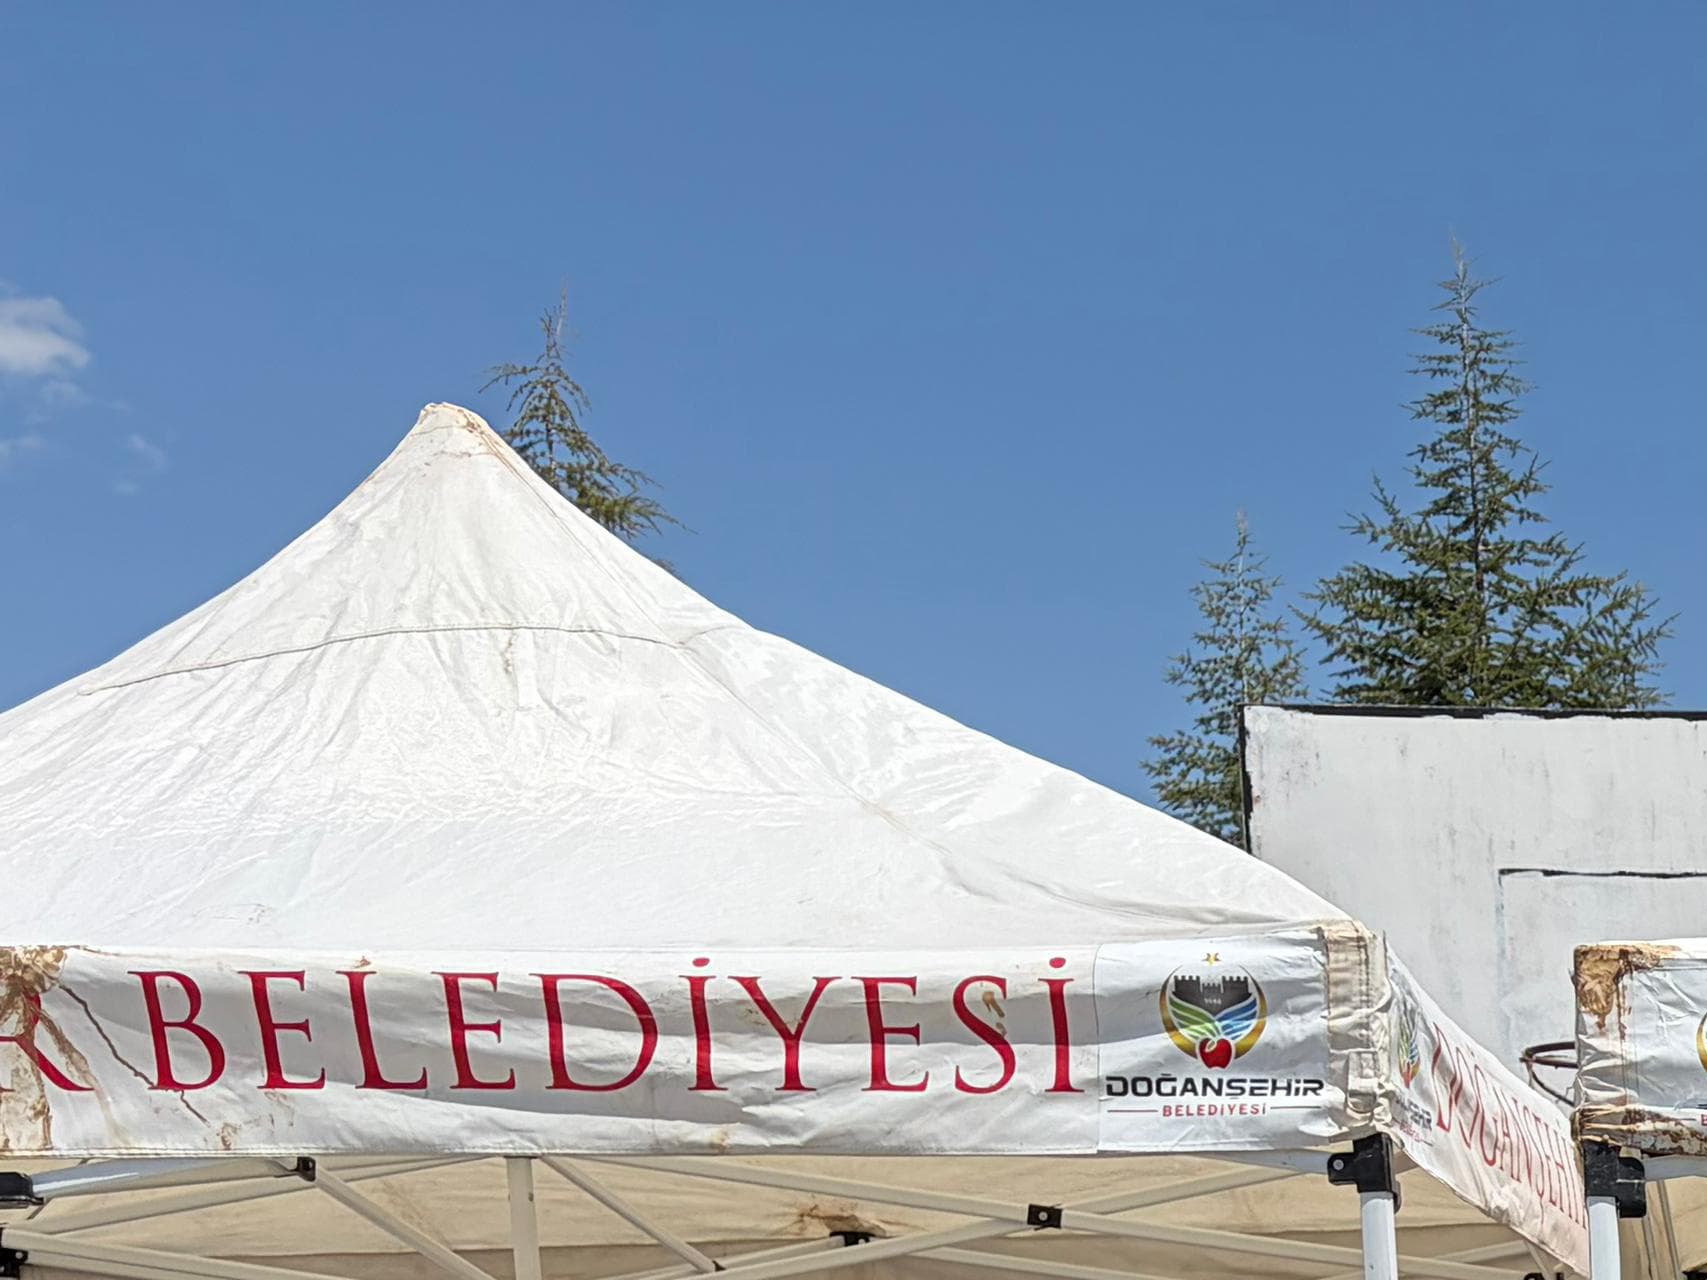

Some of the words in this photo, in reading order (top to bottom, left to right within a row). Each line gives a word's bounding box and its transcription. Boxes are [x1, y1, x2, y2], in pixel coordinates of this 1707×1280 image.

[128, 956, 1084, 1094] BELEDİYESİ
[1105, 1073, 1325, 1100] DOĞANŞEHİR
[1162, 1102, 1267, 1118] BELEDİYESİ
